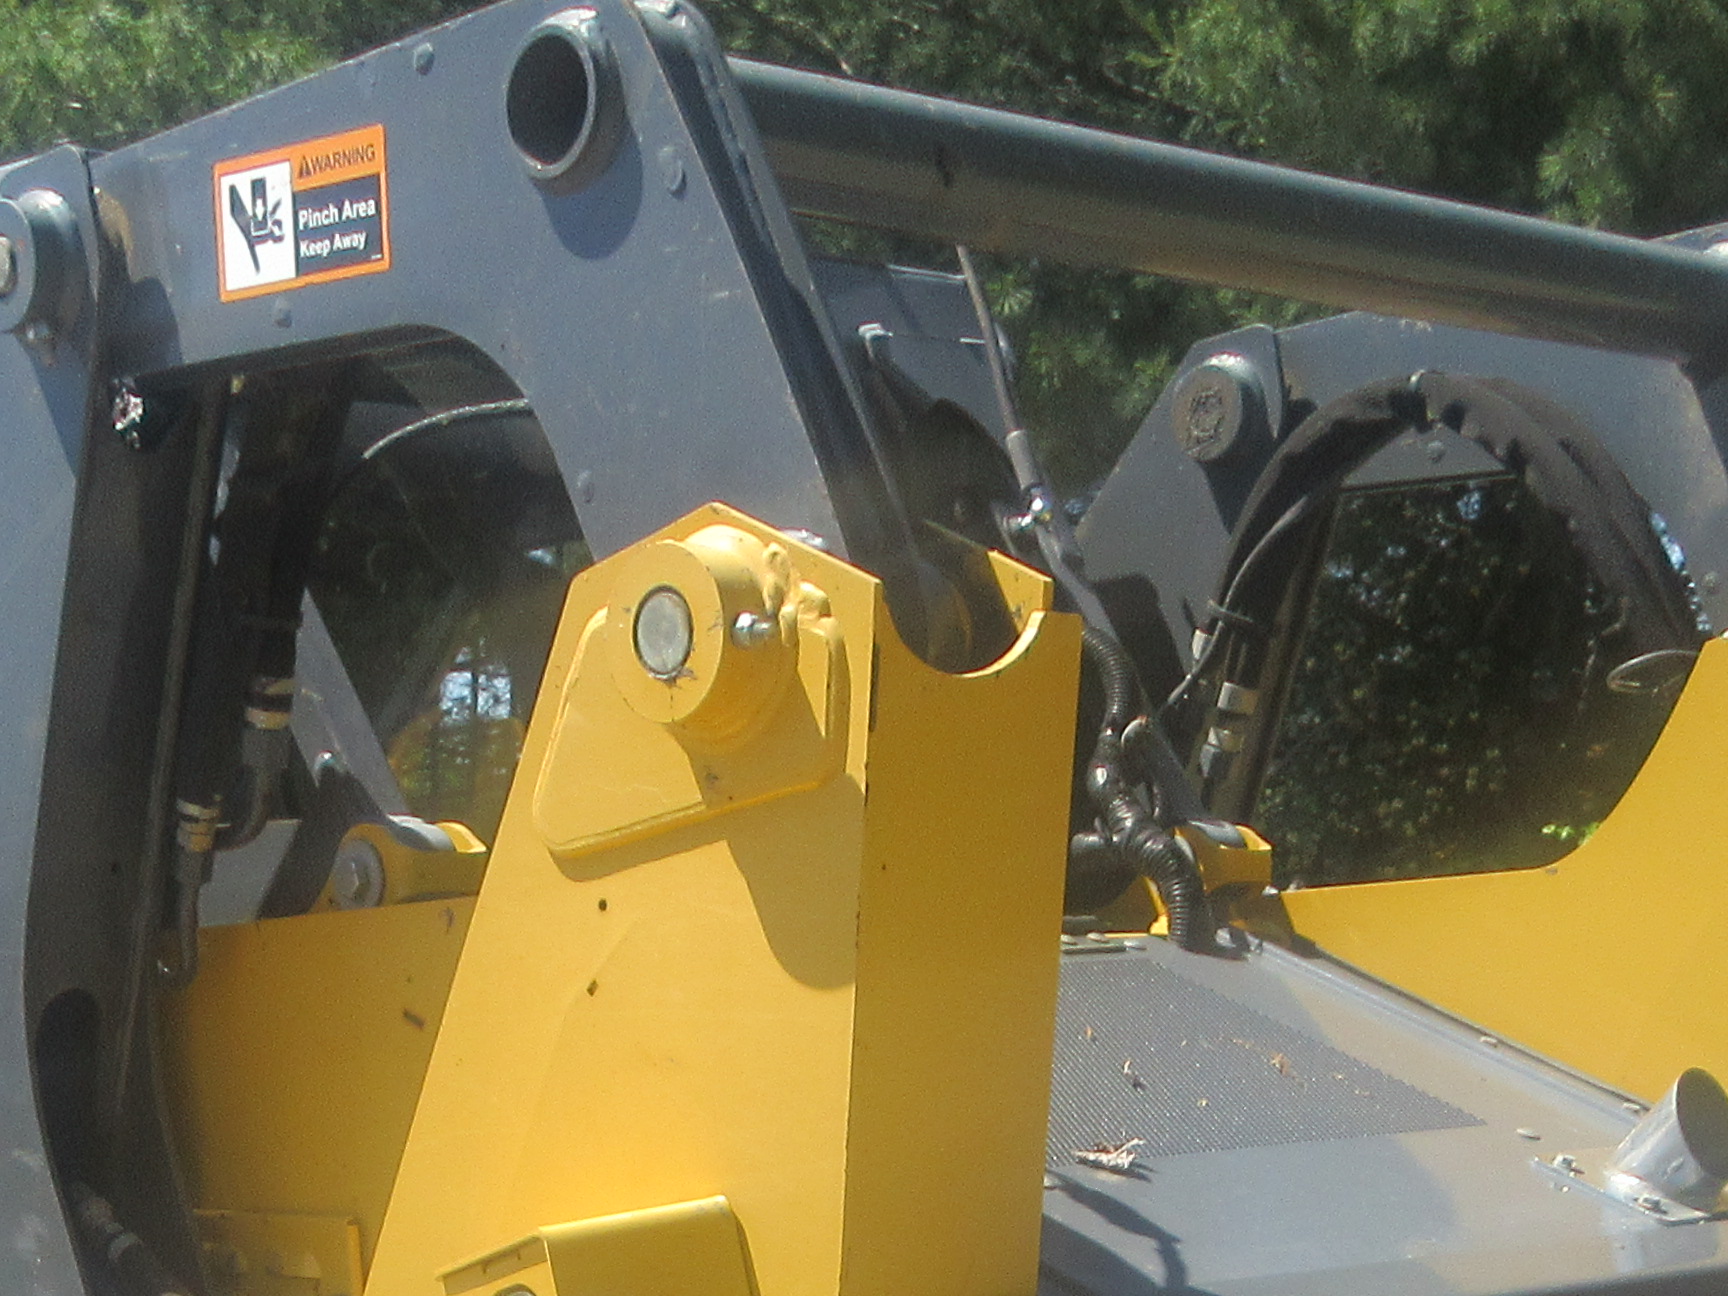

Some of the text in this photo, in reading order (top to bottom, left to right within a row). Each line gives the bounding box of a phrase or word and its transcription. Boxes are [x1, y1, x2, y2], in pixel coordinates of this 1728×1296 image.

[309, 143, 376, 173] WARNING
[298, 198, 376, 230] Pinch Area
[299, 230, 368, 258] Keep Away
